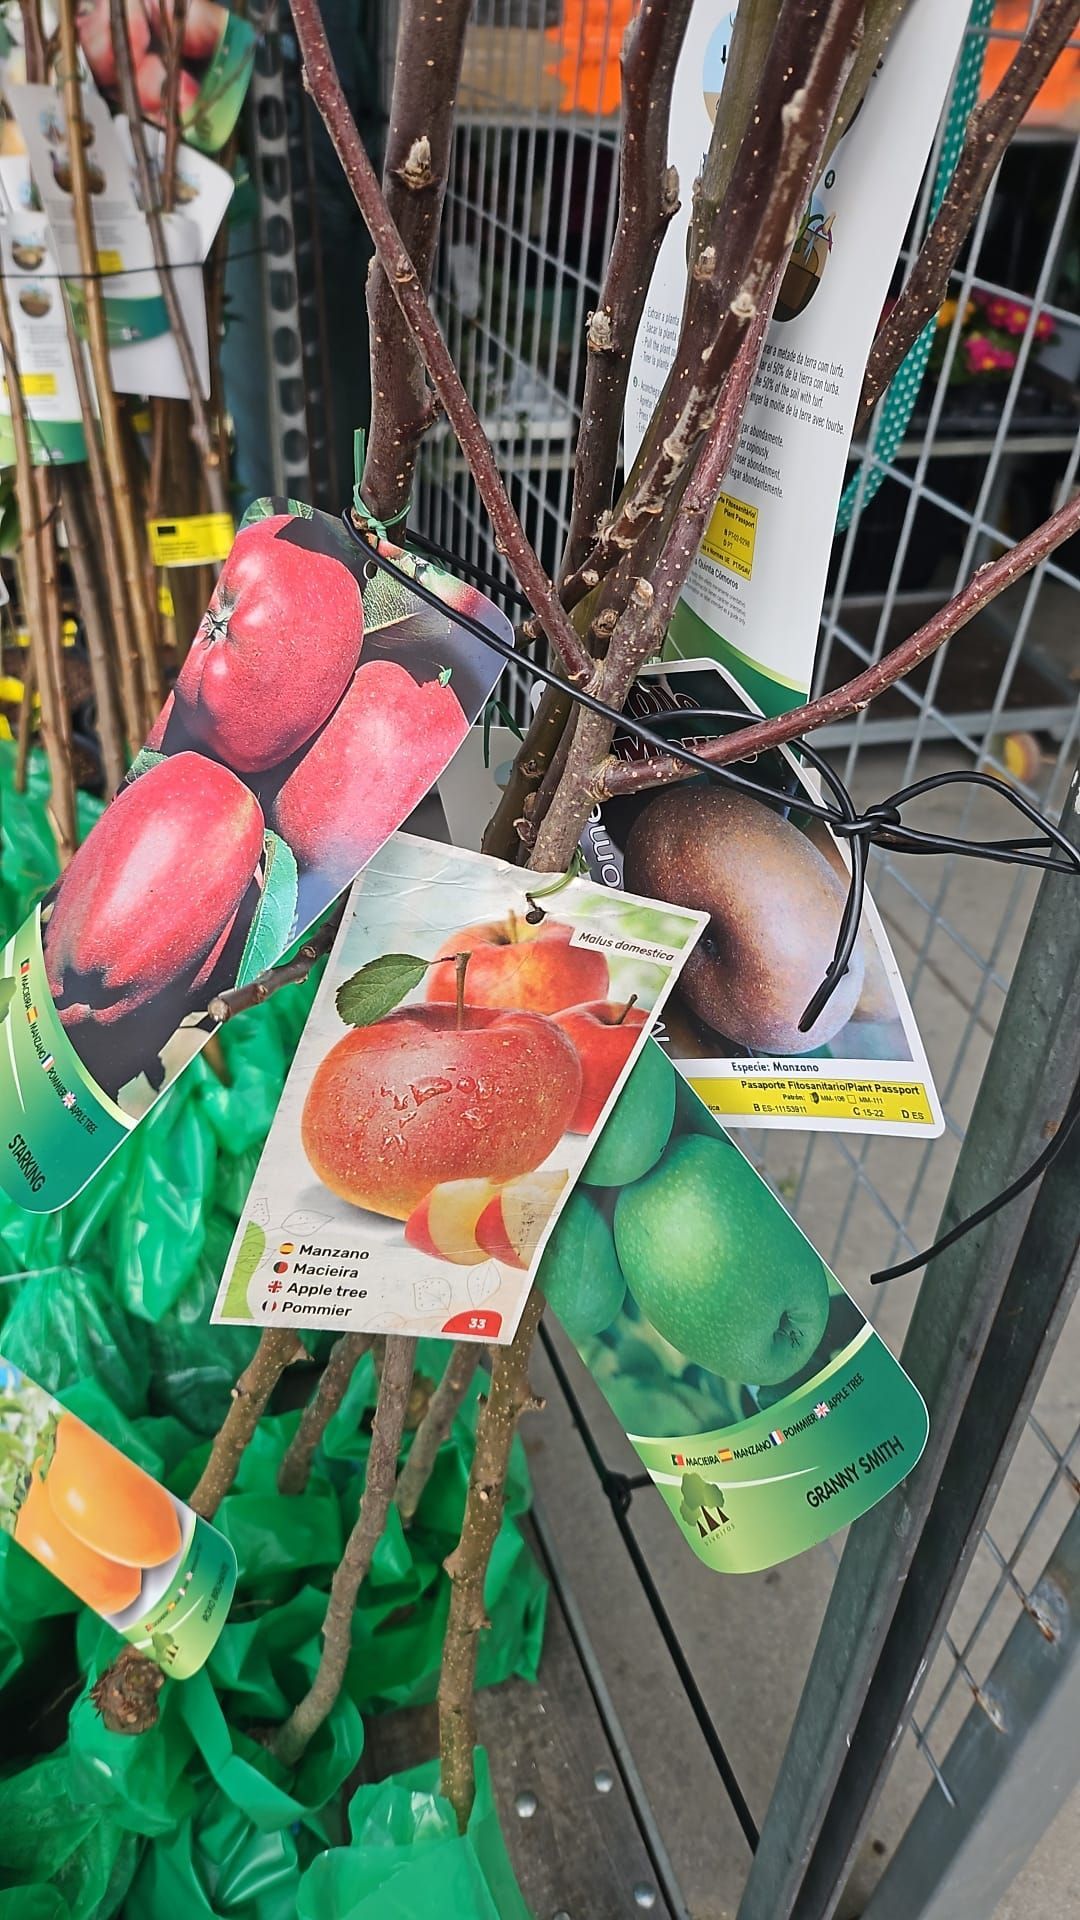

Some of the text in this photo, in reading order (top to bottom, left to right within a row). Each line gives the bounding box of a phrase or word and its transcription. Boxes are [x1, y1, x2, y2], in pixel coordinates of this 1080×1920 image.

[796, 352, 804, 364] da
[804, 355, 817, 369] terra
[817, 361, 829, 372] com
[773, 361, 785, 376] 50%
[785, 367, 793, 379] de
[799, 372, 813, 386] tierra
[763, 376, 774, 391] 50%
[780, 382, 790, 396] the
[785, 403, 793, 416] de
[799, 408, 812, 423] terre
[812, 415, 825, 428] avec
[579, 932, 675, 961] Malus domestica
[21, 974, 32, 1011] MACIEIRA
[29, 1022, 47, 1060] MANZANO
[70, 1103, 87, 1125] APPLE
[84, 1119, 98, 1135] TREE
[731, 1062, 820, 1074] Especie: Manzano
[741, 1080, 920, 1096] Pasaporte Fitosanitario/Plant Passport
[753, 1103, 761, 1112] B
[853, 1107, 860, 1116] C
[863, 1109, 885, 1117] 15-22
[901, 1110, 910, 1119] D
[912, 1112, 924, 1120] ES
[8, 1133, 46, 1193] STARKING
[299, 1244, 370, 1260] Manzano
[293, 1263, 359, 1279] Macieira
[287, 1282, 368, 1299] Apple tree
[281, 1301, 353, 1317] Pommier
[468, 1317, 487, 1330] 33
[686, 1372, 865, 1467] MACIEIRA MANZANO POMMIER APPLE TREE
[806, 1435, 905, 1508] GRANNY SMITH
[704, 1523, 736, 1547] viveiros
